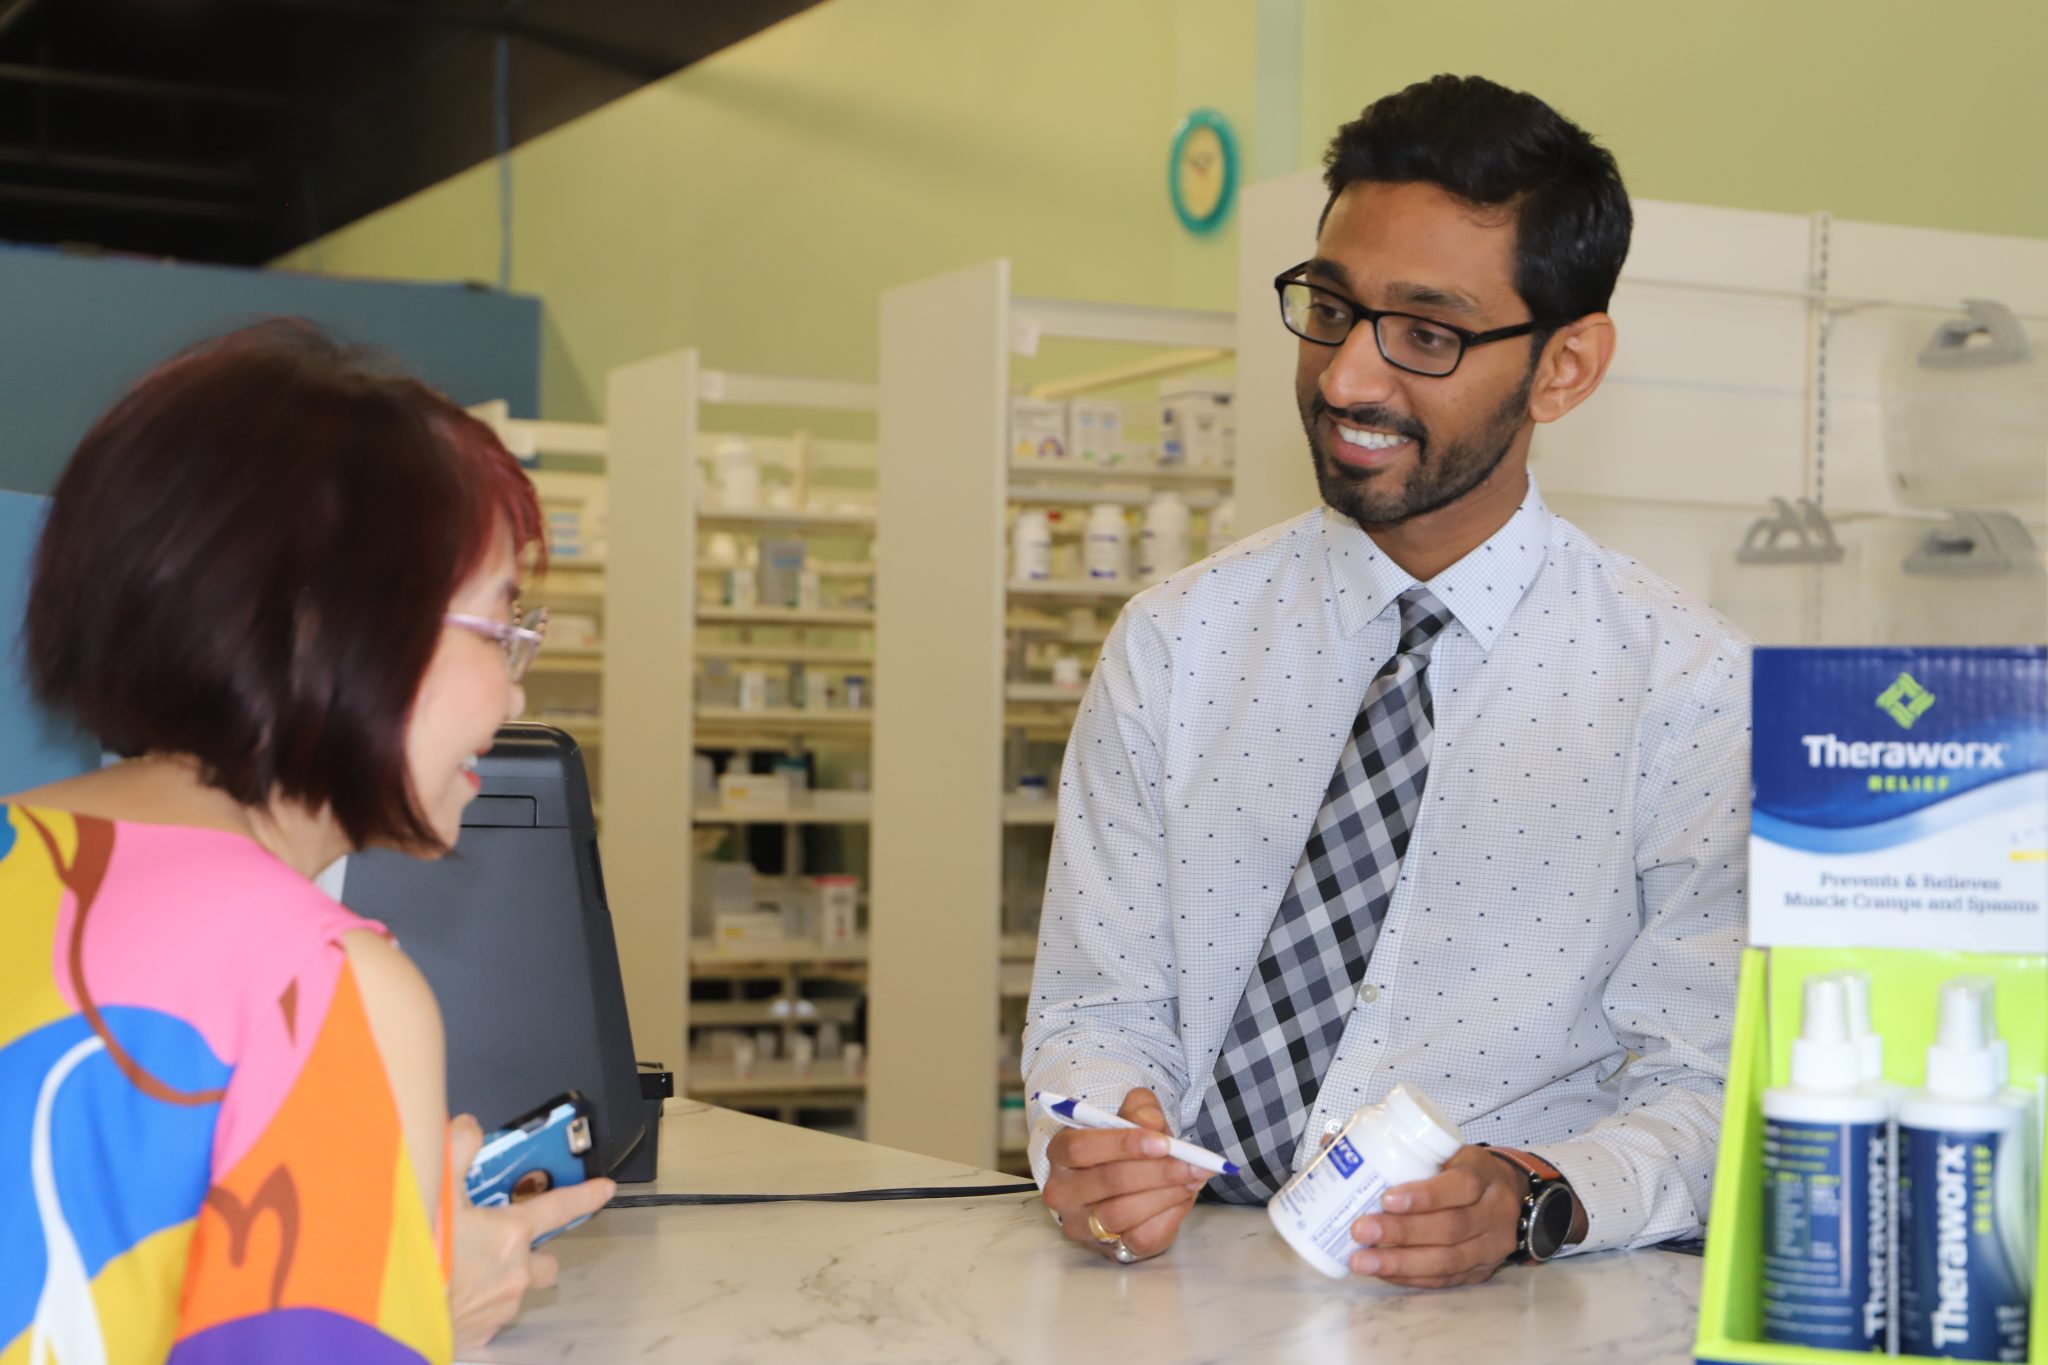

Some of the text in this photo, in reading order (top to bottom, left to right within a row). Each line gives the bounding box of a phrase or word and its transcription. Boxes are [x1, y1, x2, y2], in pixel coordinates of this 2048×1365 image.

[1802, 734, 2005, 769] Theraworx
[1867, 775, 1950, 792] RELIEF
[1819, 872, 2001, 891] Prevents & Relieves
[1784, 892, 2040, 915] Muscle Cramps and Spasms
[1972, 1145, 1992, 1235] RELIEF
[1931, 1142, 1969, 1349] Theraworx
